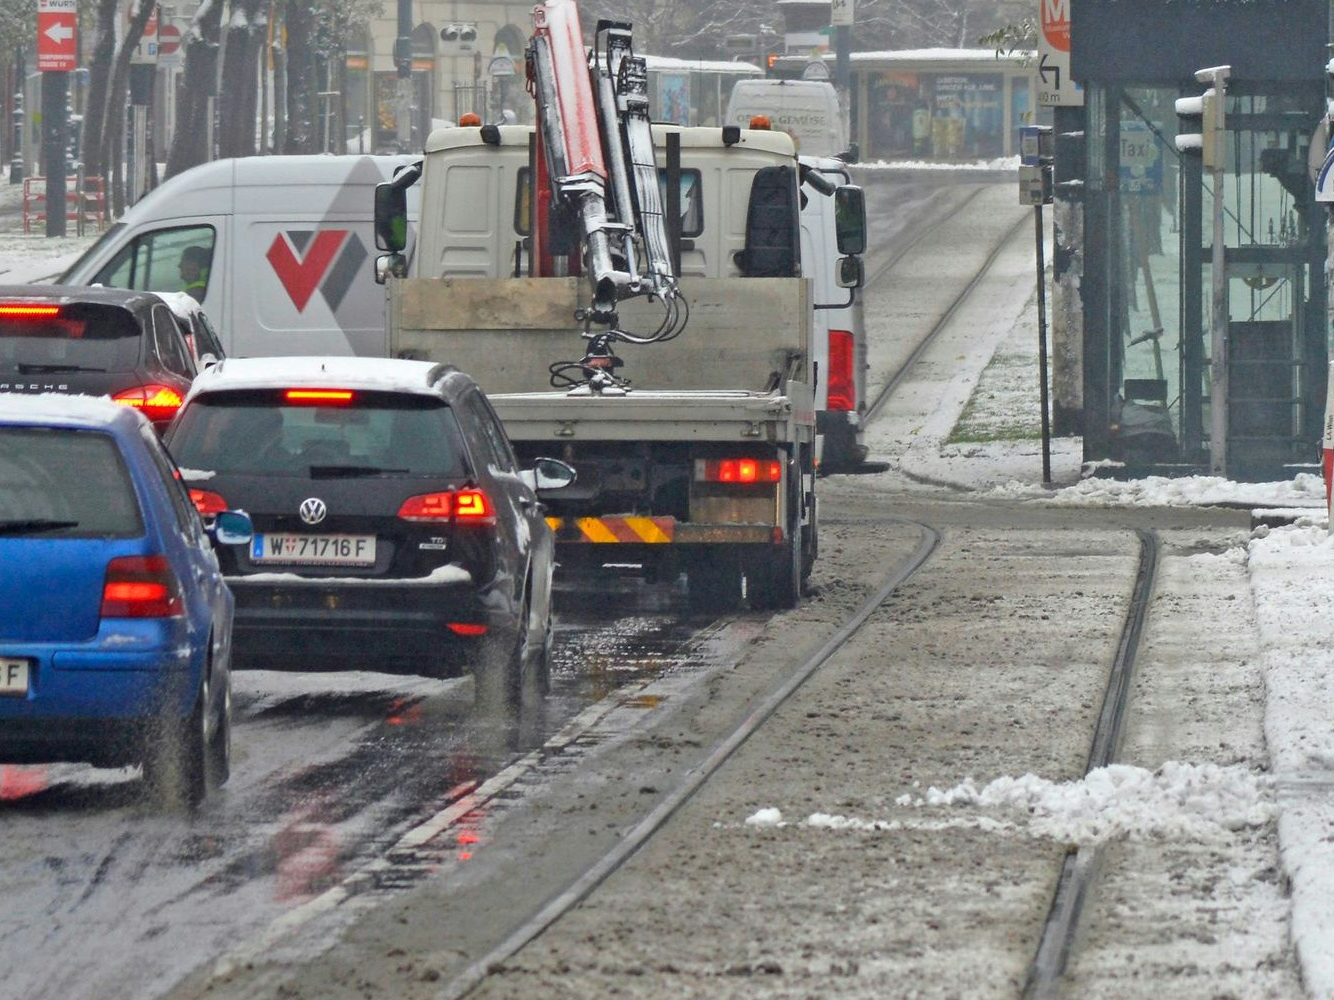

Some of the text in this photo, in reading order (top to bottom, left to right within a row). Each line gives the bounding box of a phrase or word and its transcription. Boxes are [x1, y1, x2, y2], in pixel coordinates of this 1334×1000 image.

[270, 538, 366, 557] W 71716 F
[7, 665, 20, 686] F
